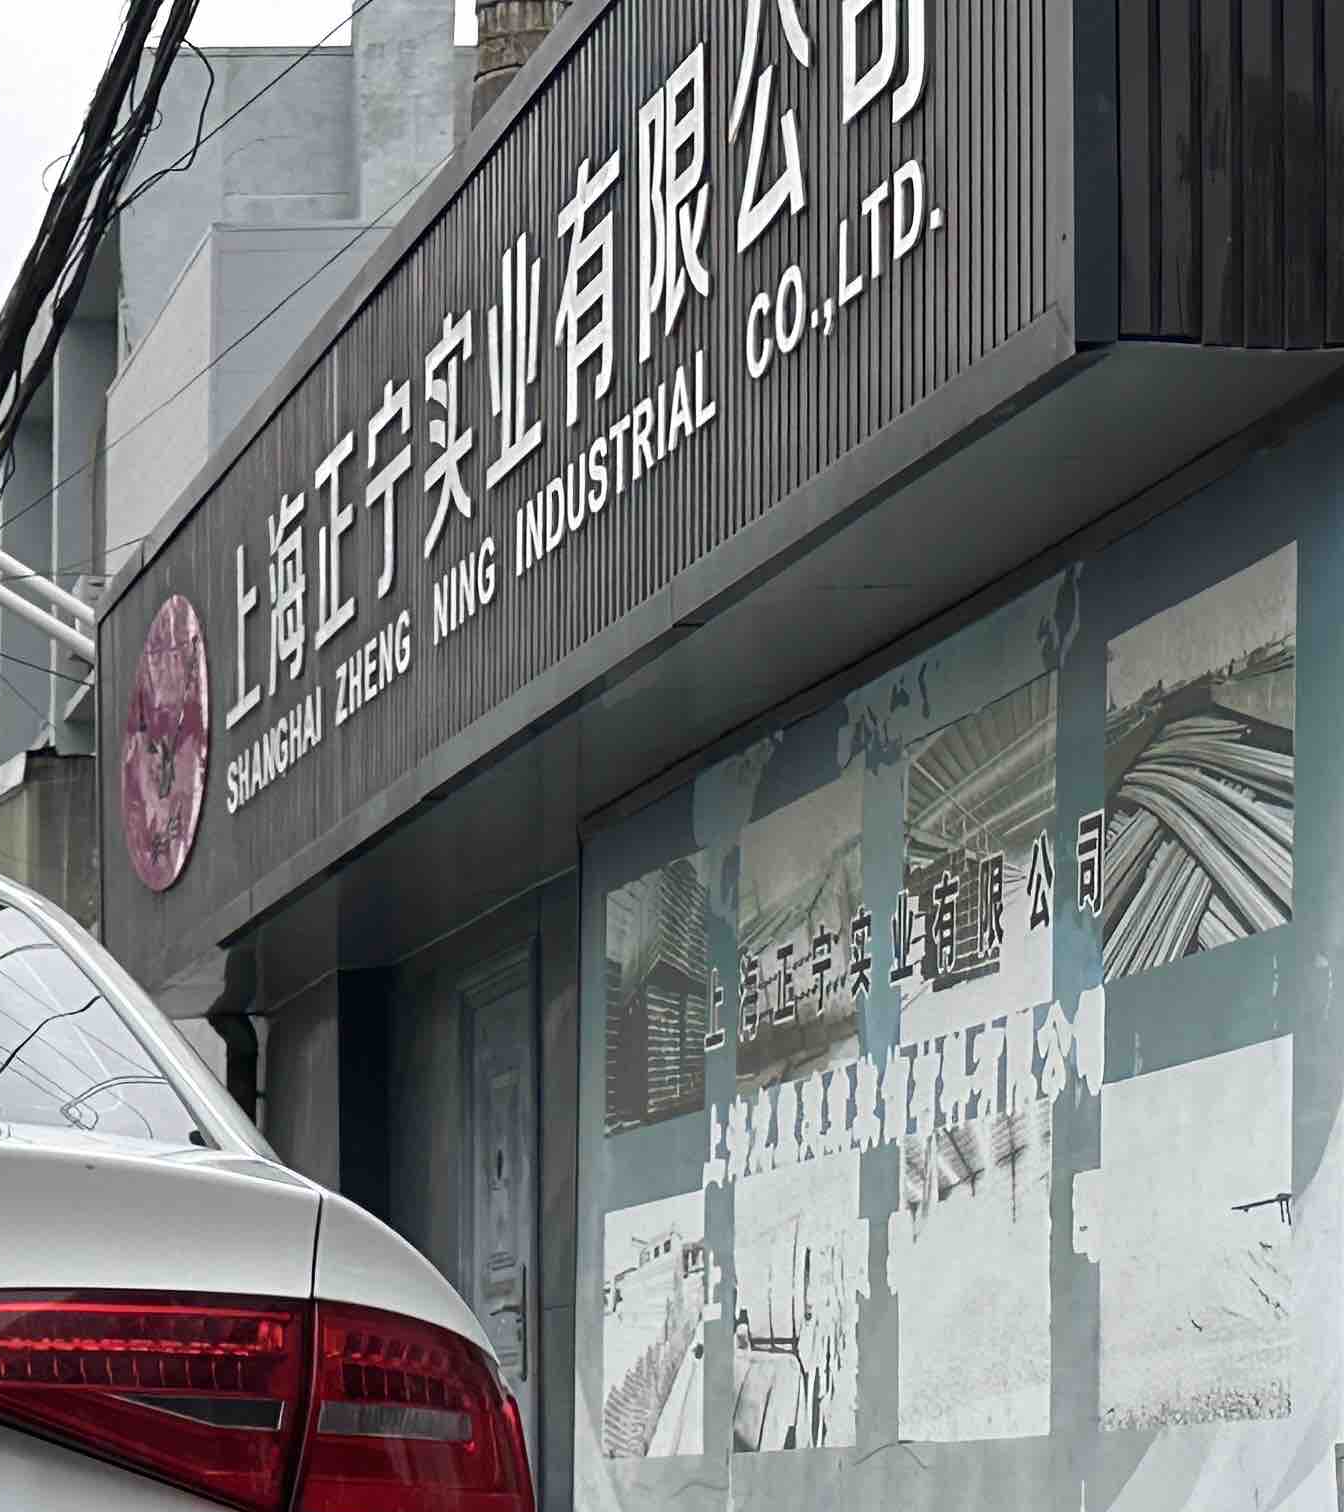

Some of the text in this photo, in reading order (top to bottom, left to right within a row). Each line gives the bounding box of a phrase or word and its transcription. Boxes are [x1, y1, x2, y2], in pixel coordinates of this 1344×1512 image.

[225, 686, 322, 814] SHANGHAI
[333, 610, 411, 727] ZHENG
[431, 535, 497, 645] NING
[516, 350, 716, 577] INDUSTRIAL
